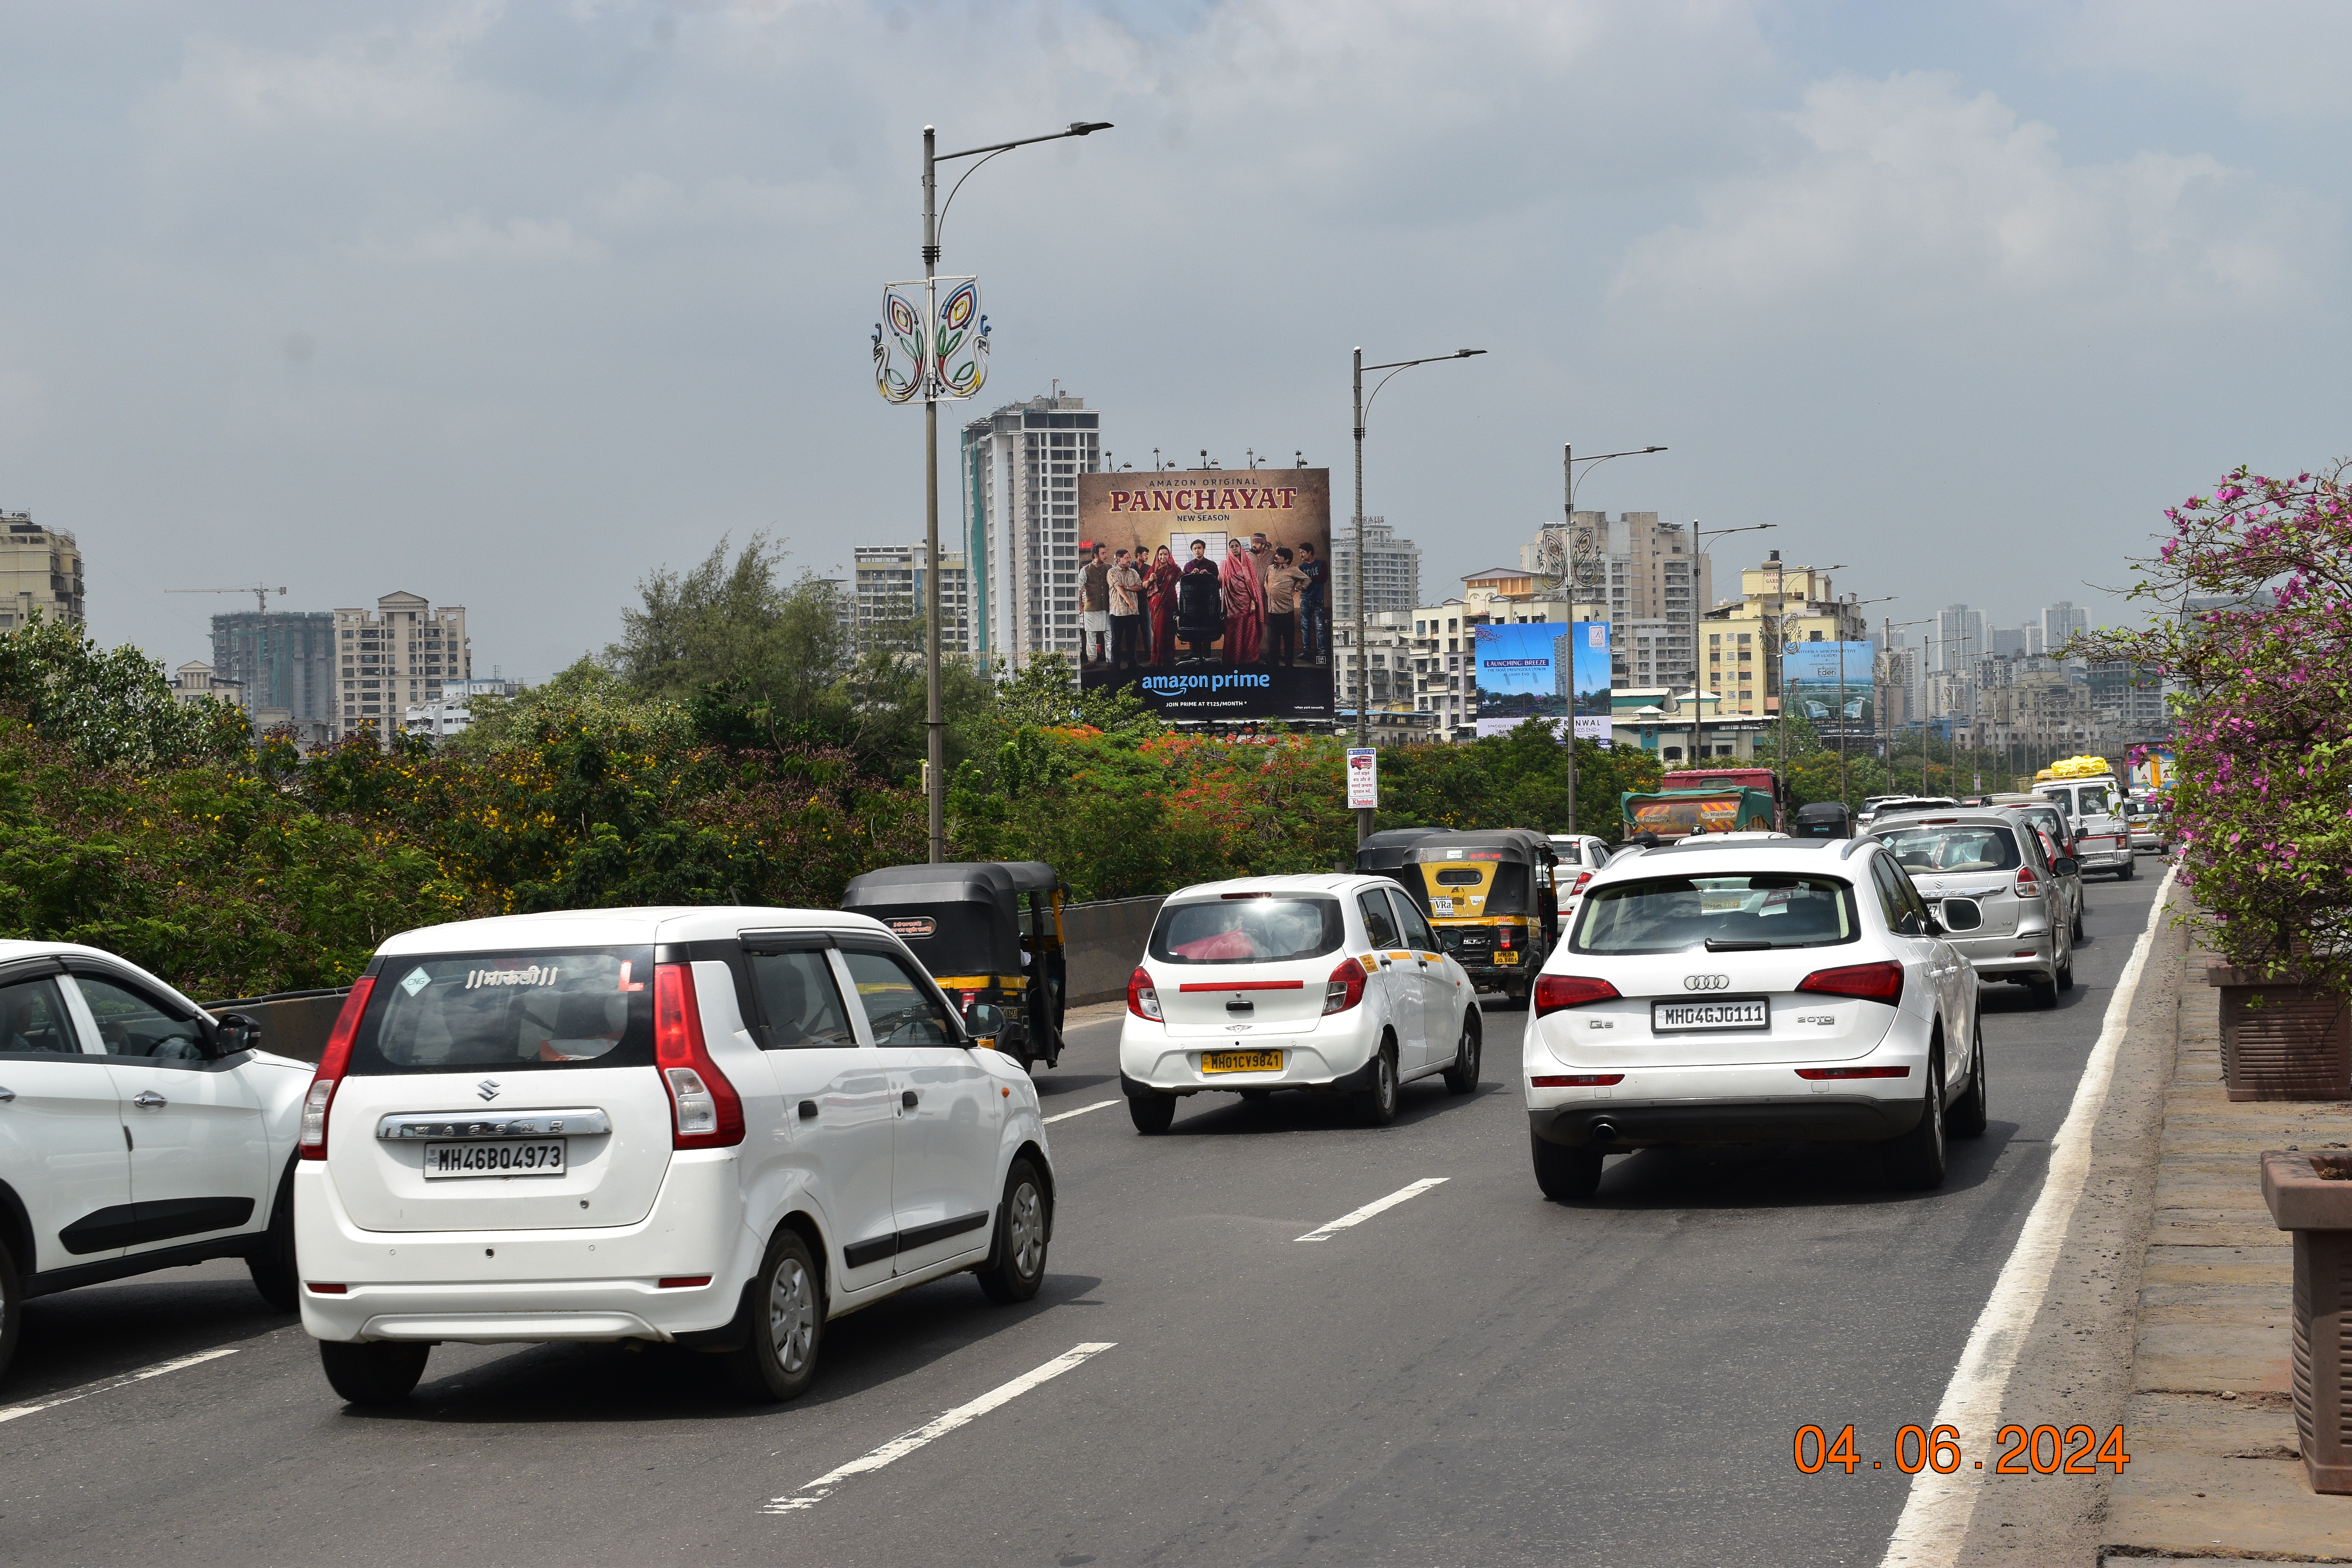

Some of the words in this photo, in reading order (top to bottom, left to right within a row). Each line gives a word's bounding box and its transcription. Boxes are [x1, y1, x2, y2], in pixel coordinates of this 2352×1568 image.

[1110, 488, 1298, 512] PANCHAYAT
[1142, 675, 1208, 689] amazon
[1212, 670, 1270, 691] prime
[1818, 667, 1836, 676] Eden
[407, 977, 426, 986] CNG
[618, 960, 644, 991] L
[1589, 1020, 1613, 1029] Q5
[1666, 1006, 1763, 1025] MH04GJ0111
[1211, 1054, 1279, 1069] MH01CV9841
[439, 1145, 561, 1171] MH46BQ4973
